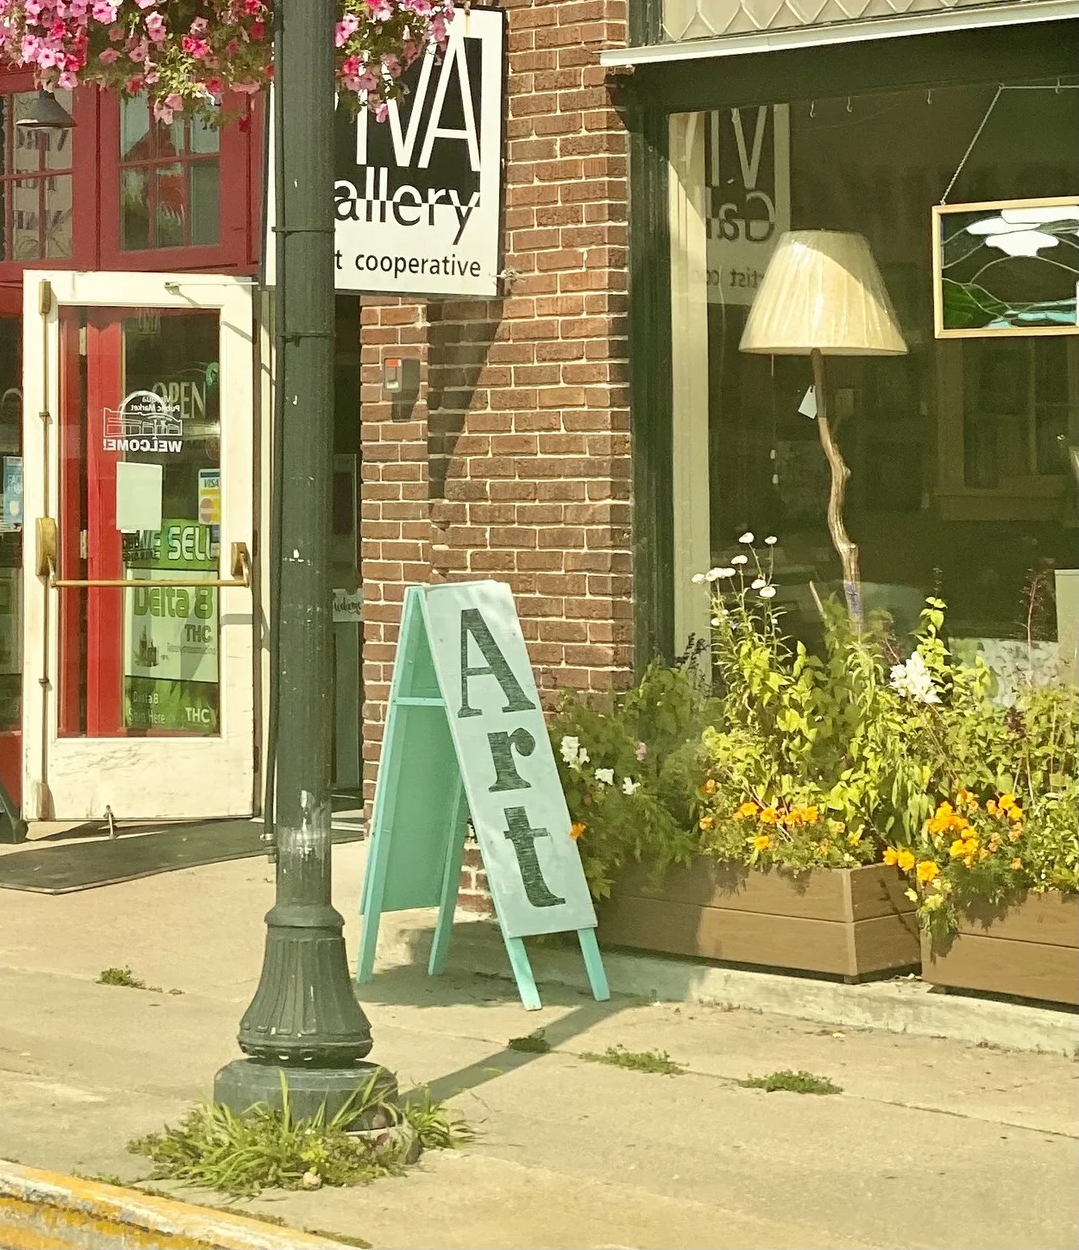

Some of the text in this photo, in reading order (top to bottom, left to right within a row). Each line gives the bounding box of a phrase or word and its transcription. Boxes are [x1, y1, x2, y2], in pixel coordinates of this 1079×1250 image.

[335, 34, 482, 172] IVA
[334, 166, 481, 246] allery
[355, 252, 482, 279] cooperative
[204, 478, 219, 488] VISA
[133, 578, 214, 620] Delta 8
[184, 624, 212, 644] THC
[148, 708, 166, 725] Here
[184, 706, 211, 724] THC
[456, 608, 566, 908] Art
